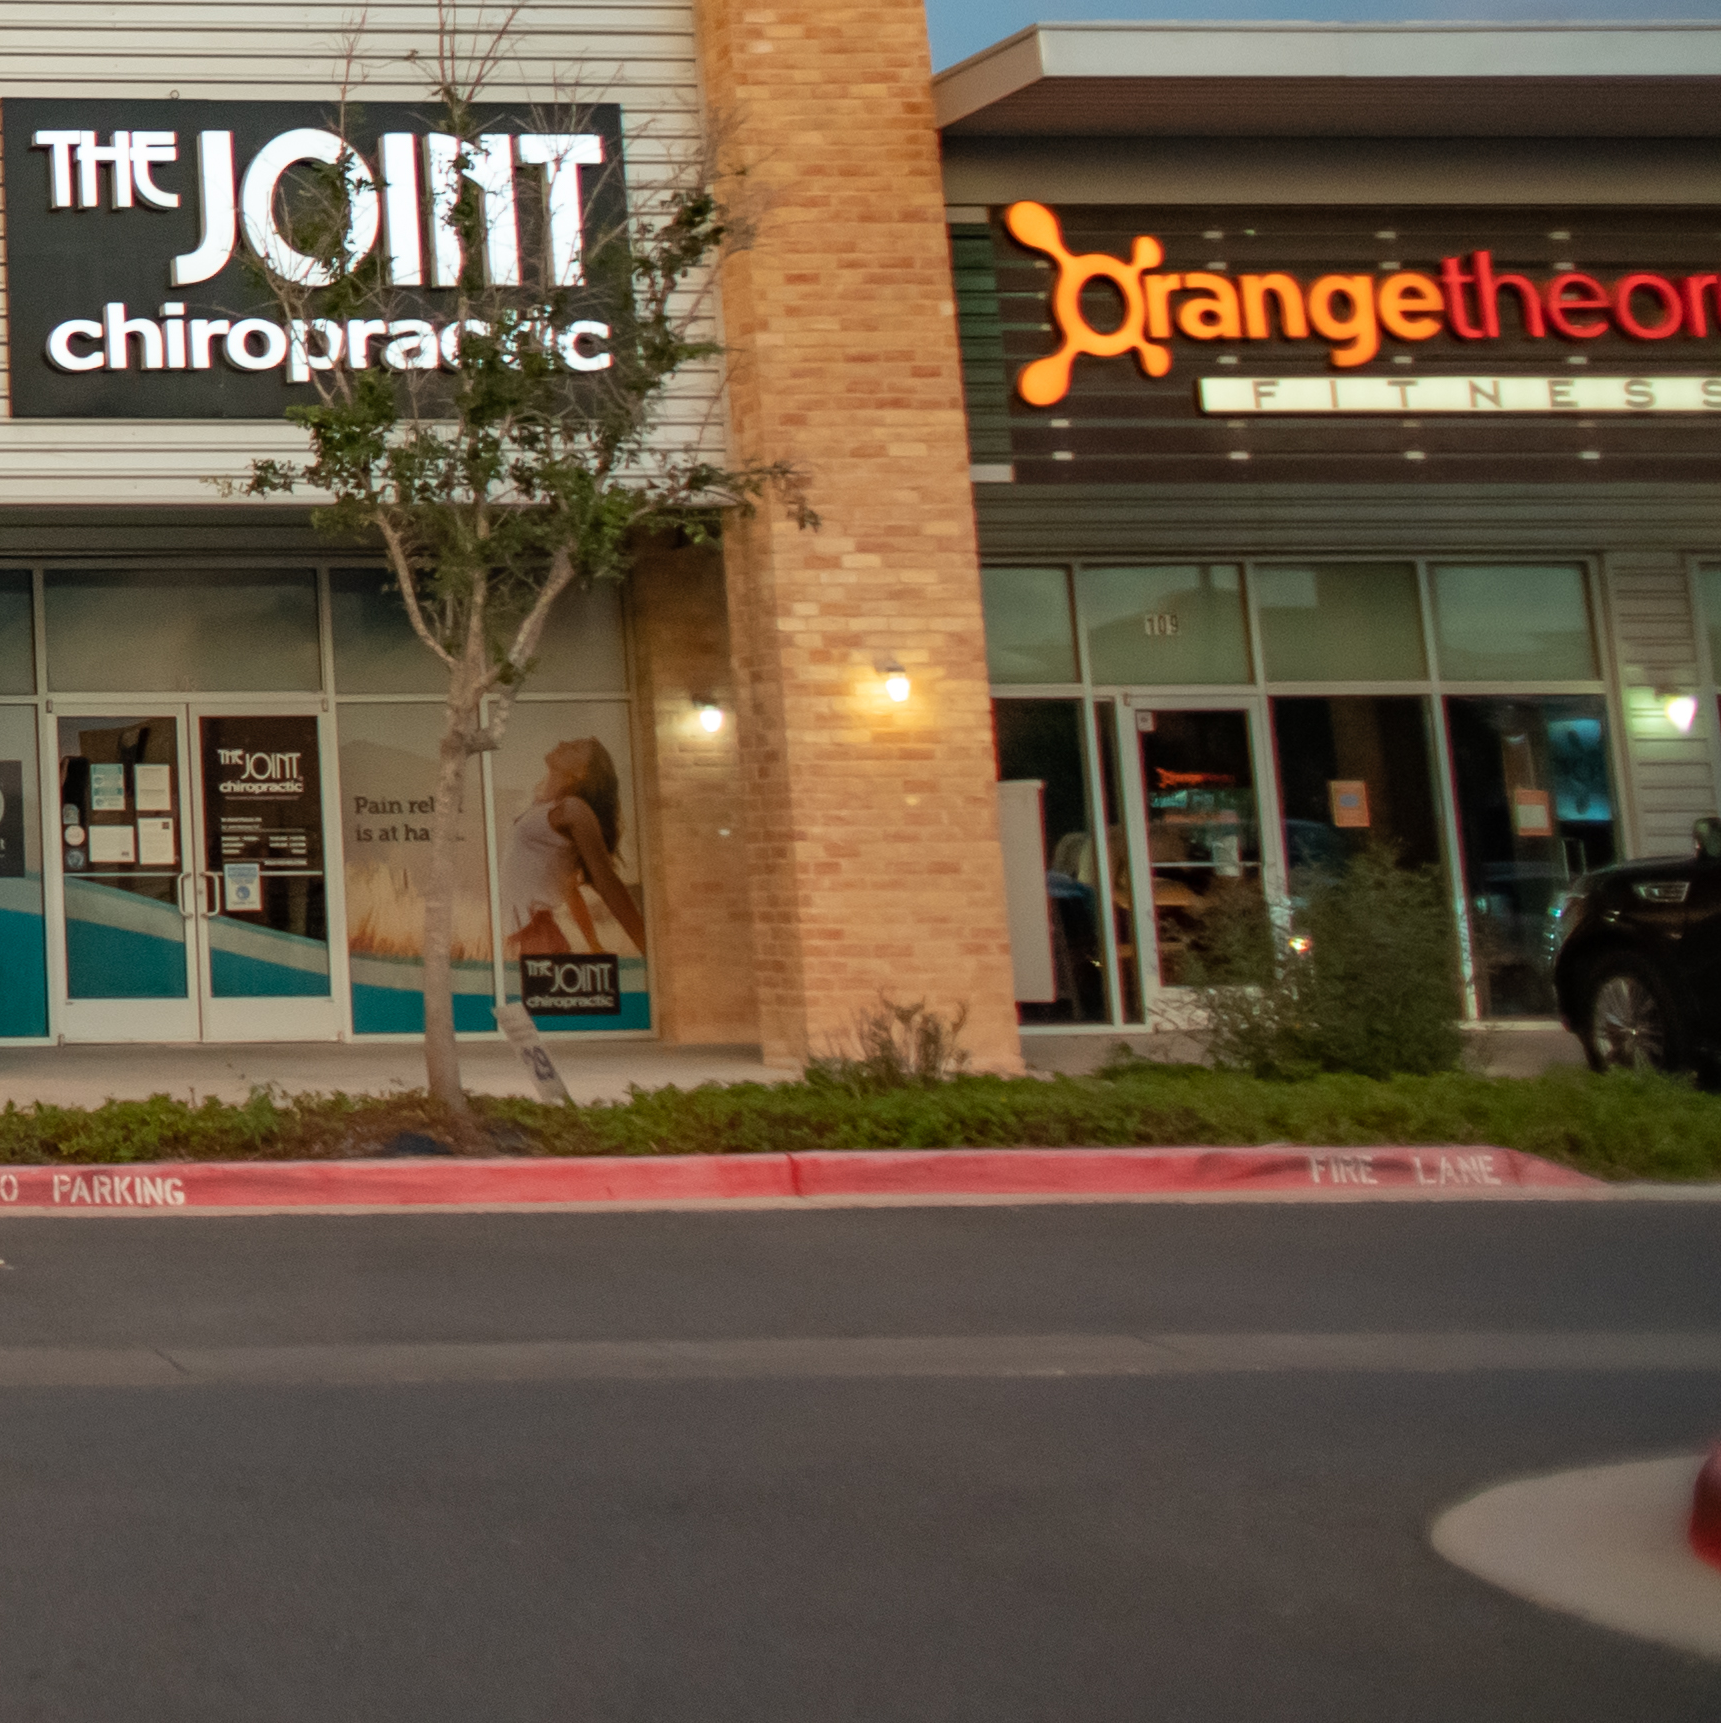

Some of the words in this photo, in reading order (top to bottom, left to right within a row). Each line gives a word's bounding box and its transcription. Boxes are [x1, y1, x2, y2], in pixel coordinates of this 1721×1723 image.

[32, 130, 181, 210] THE
[170, 127, 607, 289] JOINT
[1251, 378, 1721, 409] FITNESS
[240, 752, 301, 780] JOINT
[219, 780, 304, 794] chiropractic
[354, 796, 404, 815] Pain
[356, 824, 373, 841] is
[378, 825, 399, 842] at
[550, 962, 613, 993] JOINT
[526, 995, 616, 1009] chiropractic
[1309, 1154, 1378, 1185] FIRE
[1414, 1154, 1502, 1186] LANE
[53, 1174, 186, 1206] PARKING
